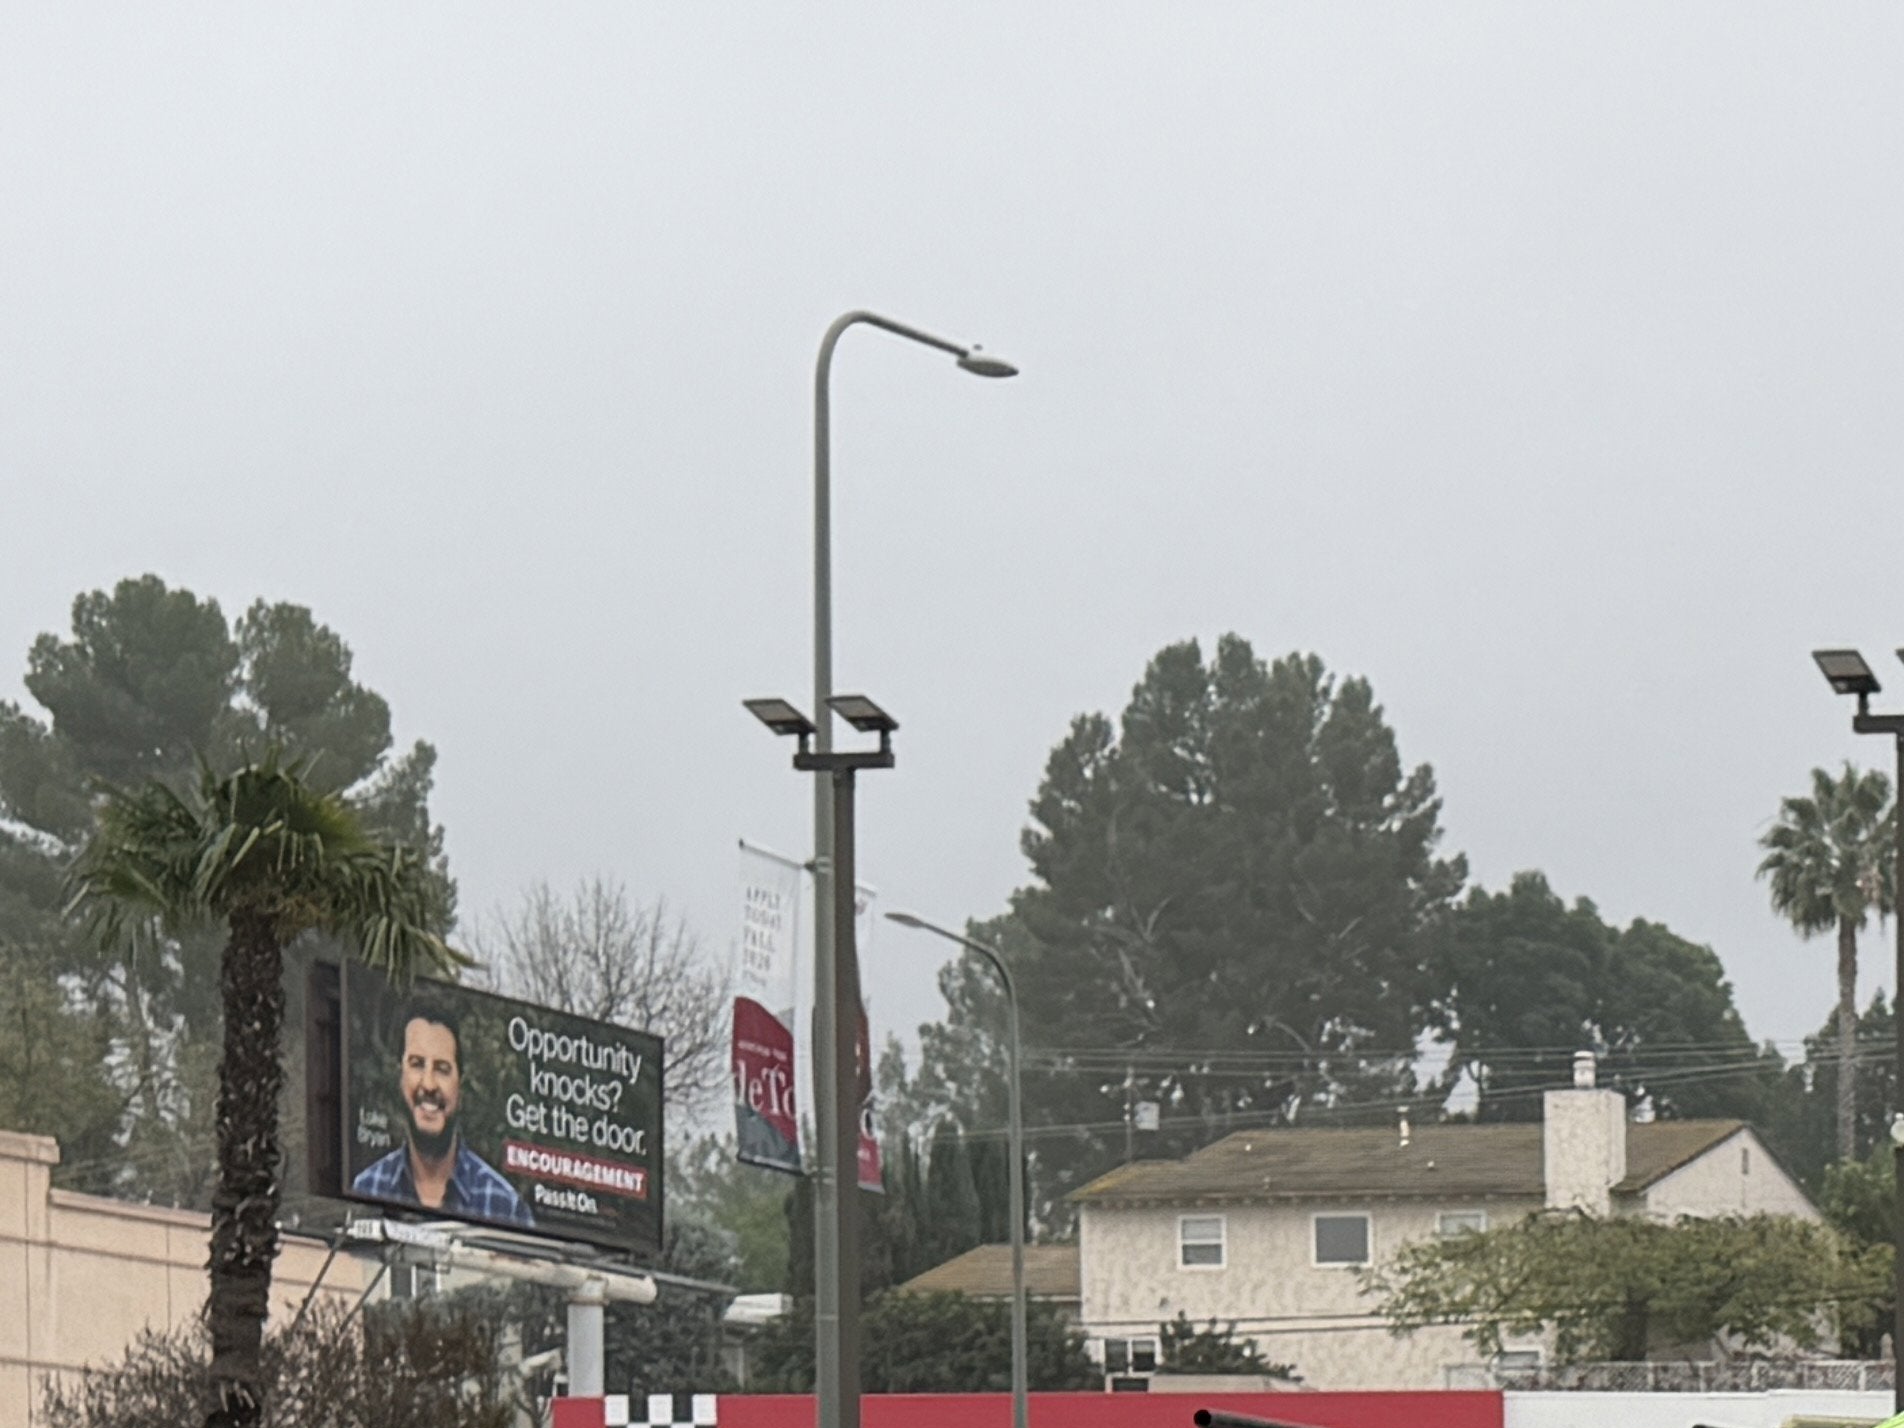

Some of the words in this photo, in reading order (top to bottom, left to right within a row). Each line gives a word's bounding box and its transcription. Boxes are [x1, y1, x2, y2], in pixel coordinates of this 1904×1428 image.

[508, 1016, 642, 1084] Opportunity
[530, 1062, 623, 1113] knocks?
[506, 1093, 548, 1135] Get
[552, 1104, 588, 1143] the
[592, 1114, 647, 1156] door.
[506, 1144, 644, 1192] ENCOURAGEMENT
